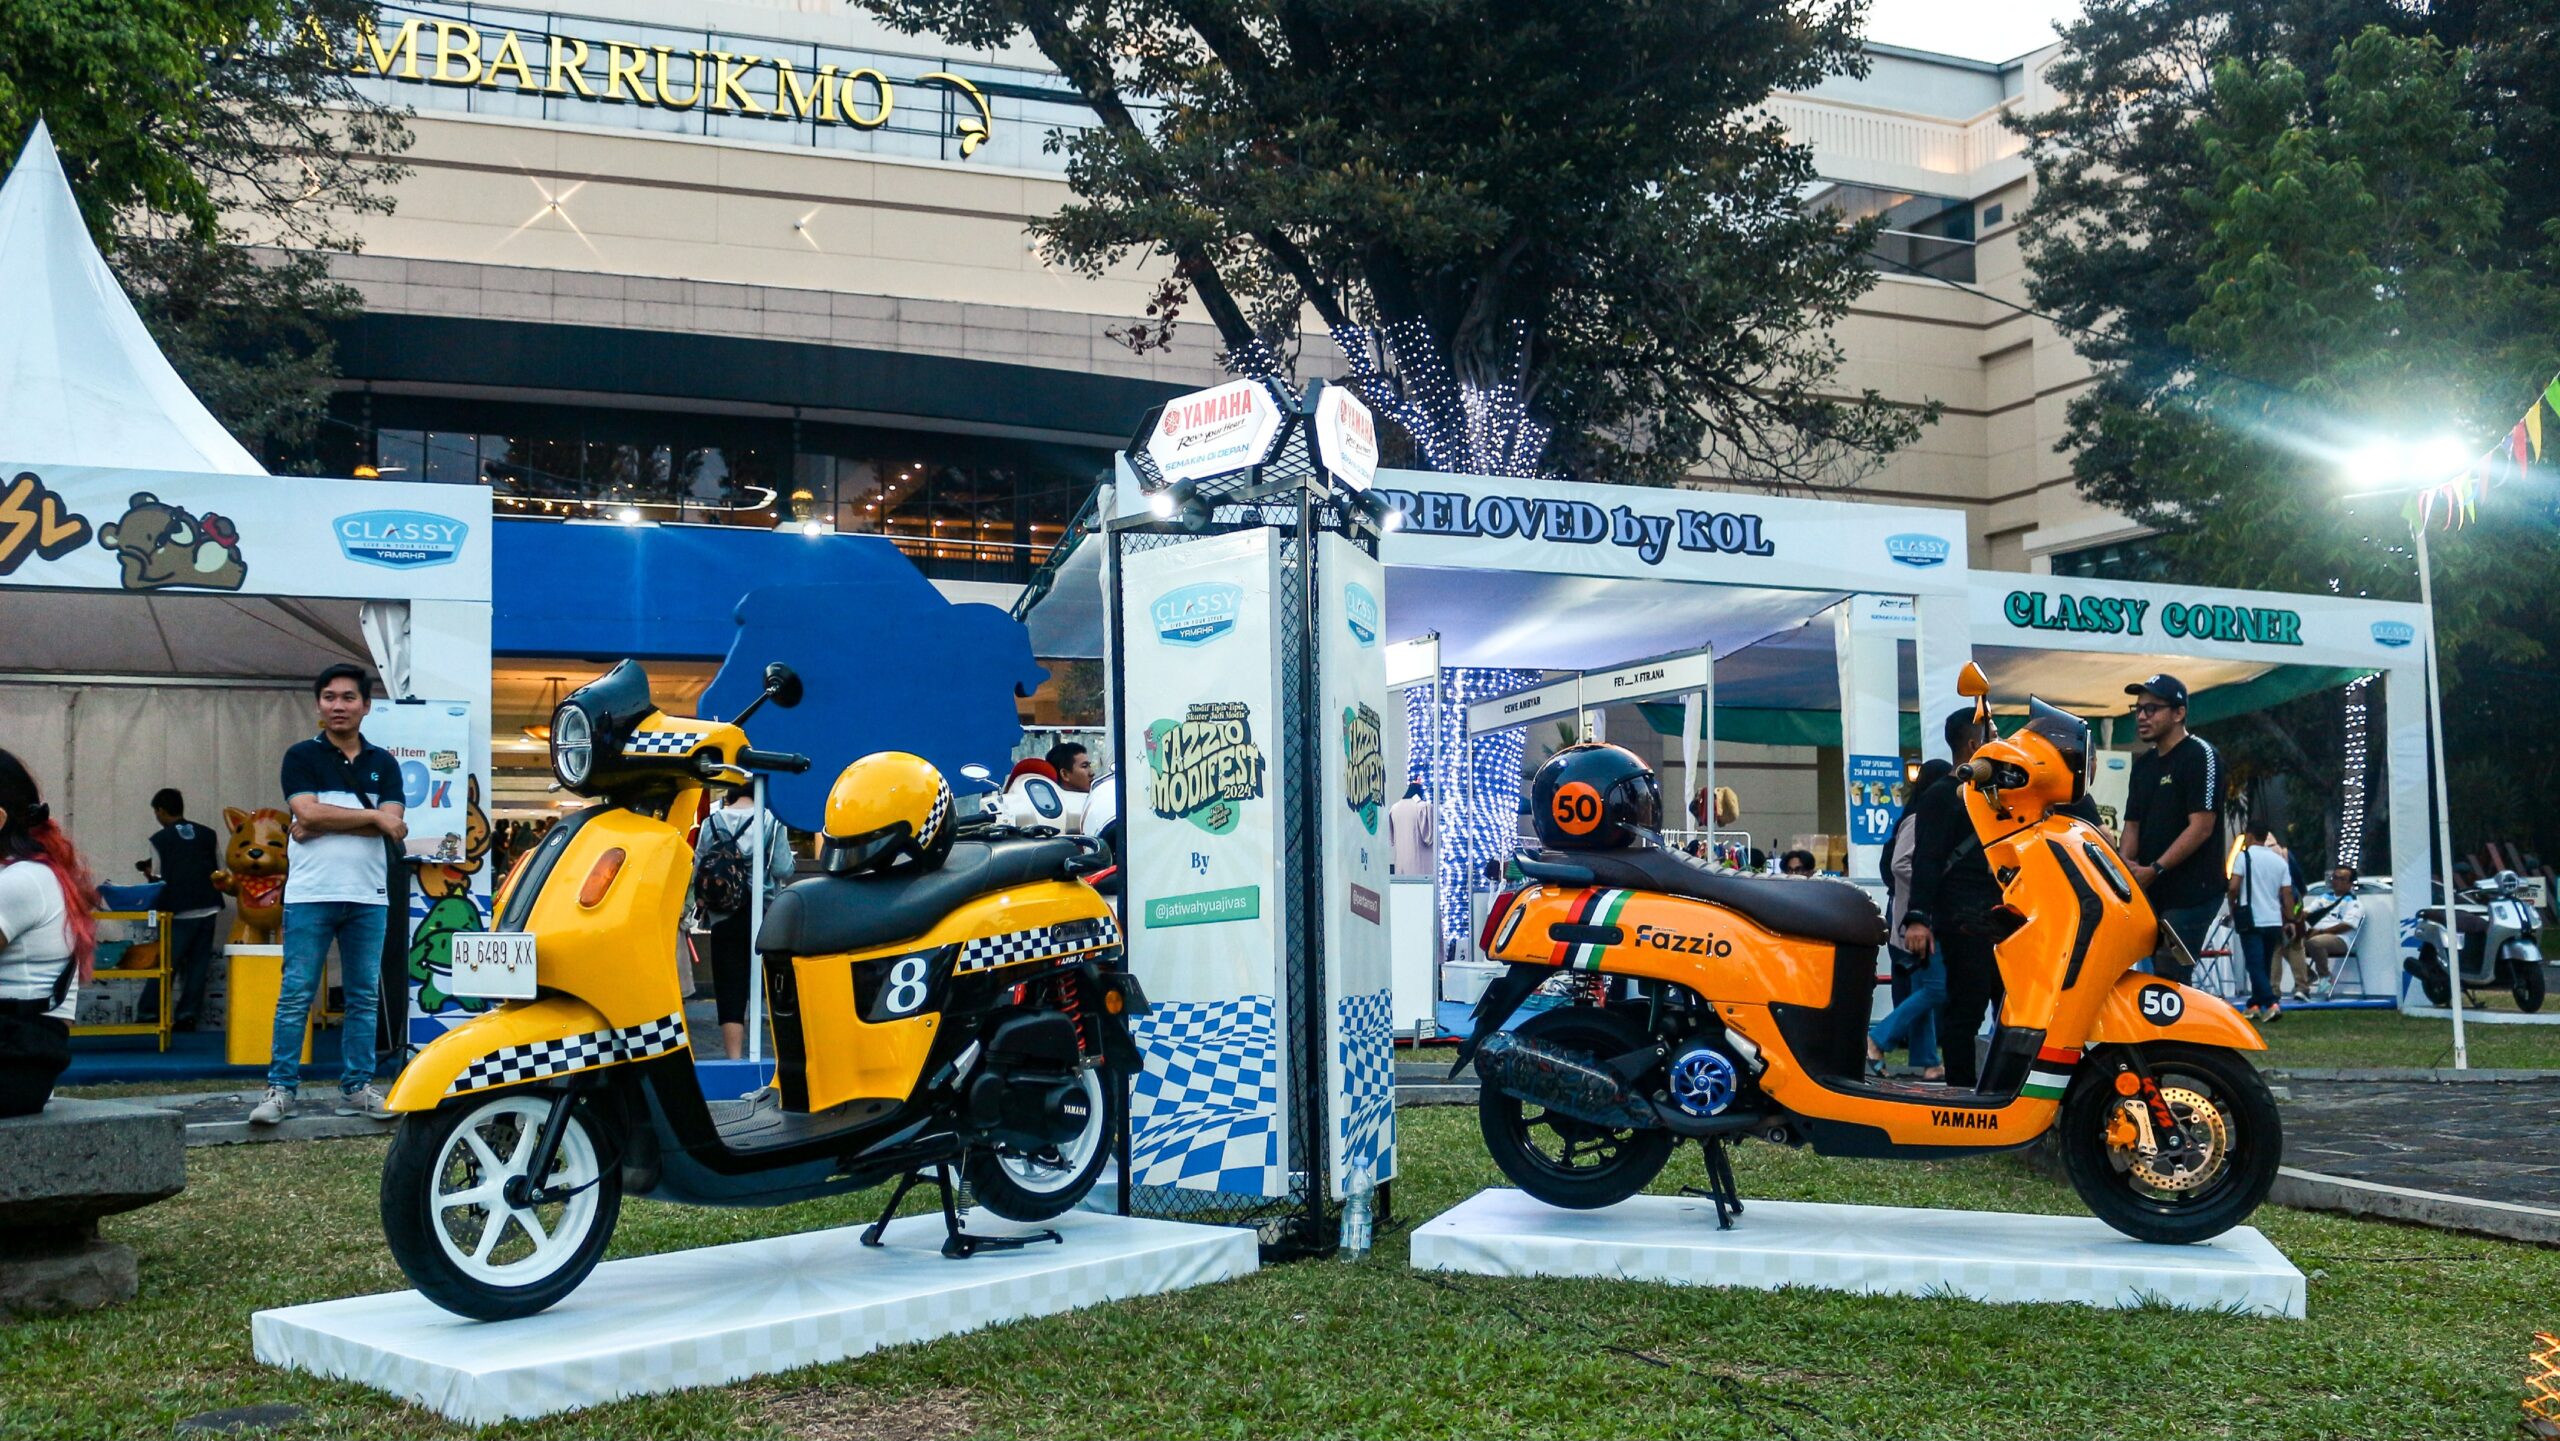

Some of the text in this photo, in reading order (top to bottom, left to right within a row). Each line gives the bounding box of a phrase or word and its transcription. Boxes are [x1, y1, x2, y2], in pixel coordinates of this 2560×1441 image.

[1183, 389, 1251, 430] YAMAHA
[1165, 443, 1249, 472] SEMAKIN DI DEPAN
[342, 520, 459, 541] CLASSY
[1610, 505, 1674, 565] by
[1676, 509, 1774, 556] KOL
[377, 550, 426, 560] YAMAHA
[1889, 540, 1945, 553] CLASSY
[1156, 590, 1236, 621] CLASSY
[2004, 590, 2304, 645] CLASSY CORNER
[1180, 625, 1214, 638] YAMAHA
[1504, 702, 1518, 714] CEWE
[401, 747, 426, 757] Item
[1162, 719, 1244, 774] FAZZIO
[1150, 744, 1260, 813] MODIFEST
[1223, 784, 1252, 799] 2024
[1558, 794, 1597, 823] 50
[1866, 808, 1889, 834] 19
[1191, 852, 1210, 875] By
[1155, 897, 1247, 919] @jatiwahyuajivas
[455, 941, 532, 964] AB 6489 XX
[1635, 924, 1732, 958] Fazzio
[886, 958, 927, 1012] 8
[2143, 989, 2181, 1017] 50
[1064, 1104, 1086, 1116] YAMAHA
[1931, 1110, 1998, 1130] YAMAHA
